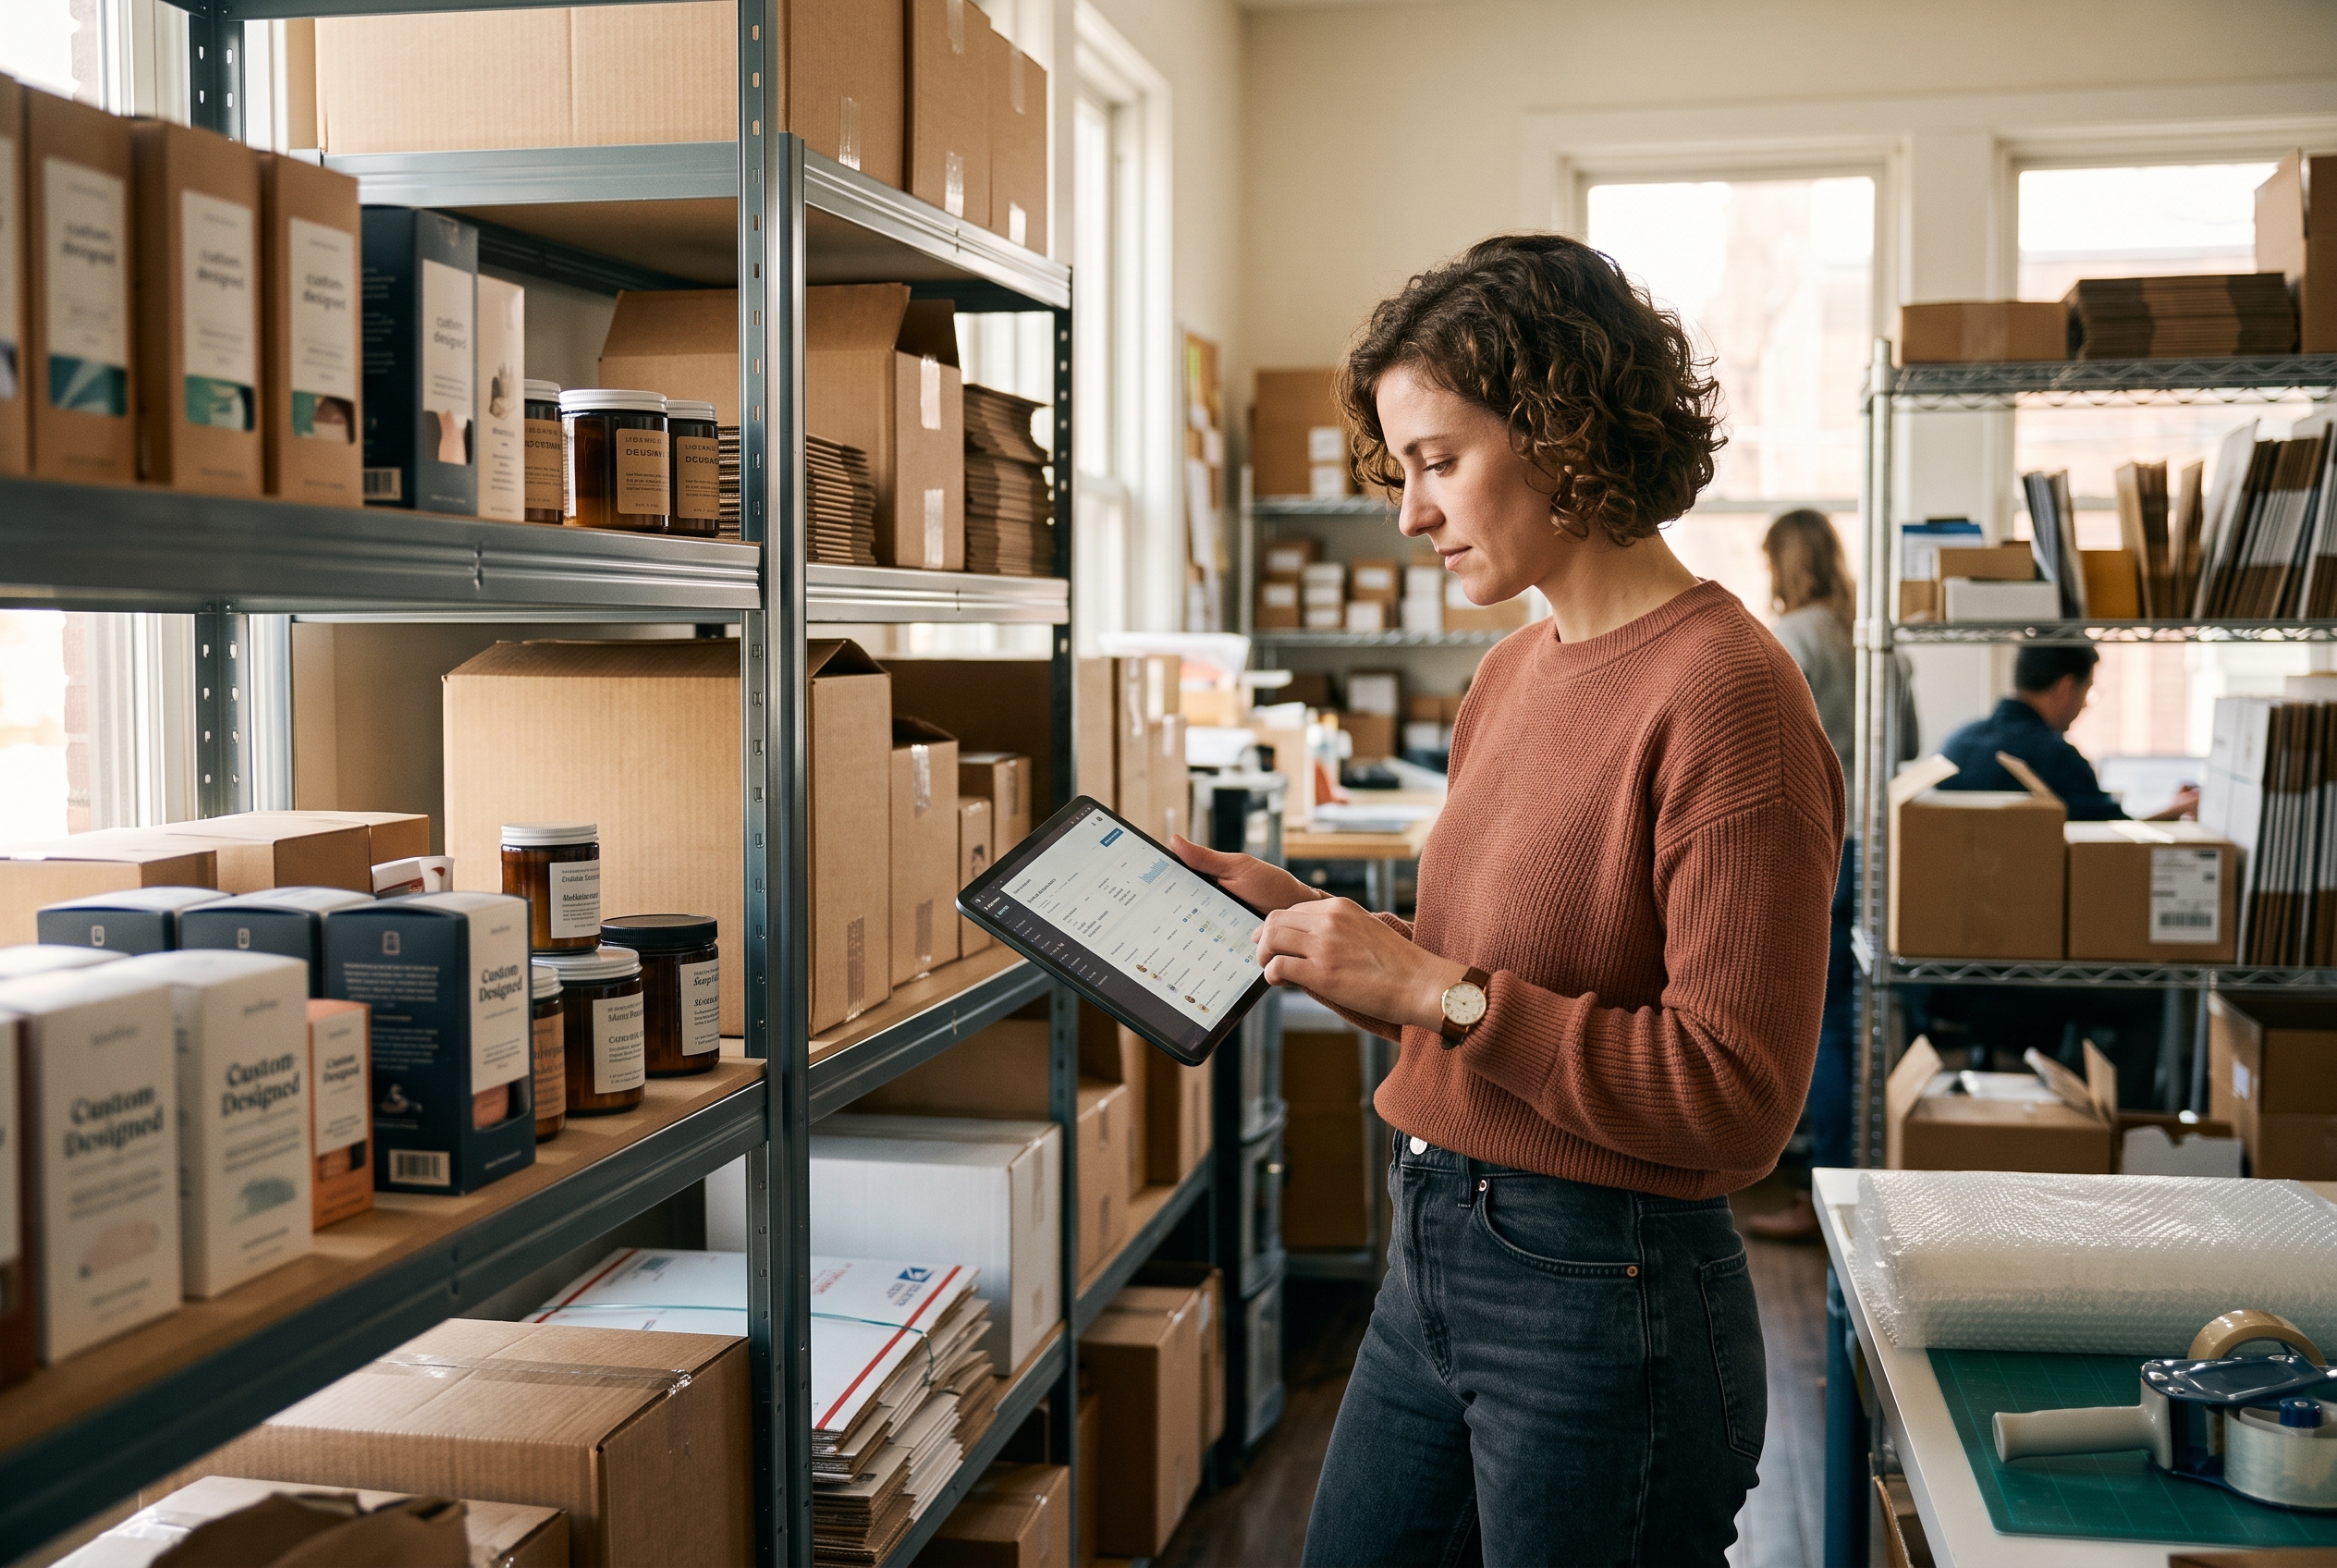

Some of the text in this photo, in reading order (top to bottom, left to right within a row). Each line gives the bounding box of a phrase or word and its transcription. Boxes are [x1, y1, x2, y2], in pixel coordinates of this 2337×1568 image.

[479, 975, 523, 1002] Designed
[482, 964, 519, 984] Custom
[226, 1053, 294, 1087] Custom
[68, 1085, 156, 1126] Custom
[220, 1072, 300, 1118] Designed
[63, 1104, 165, 1158] Designed
